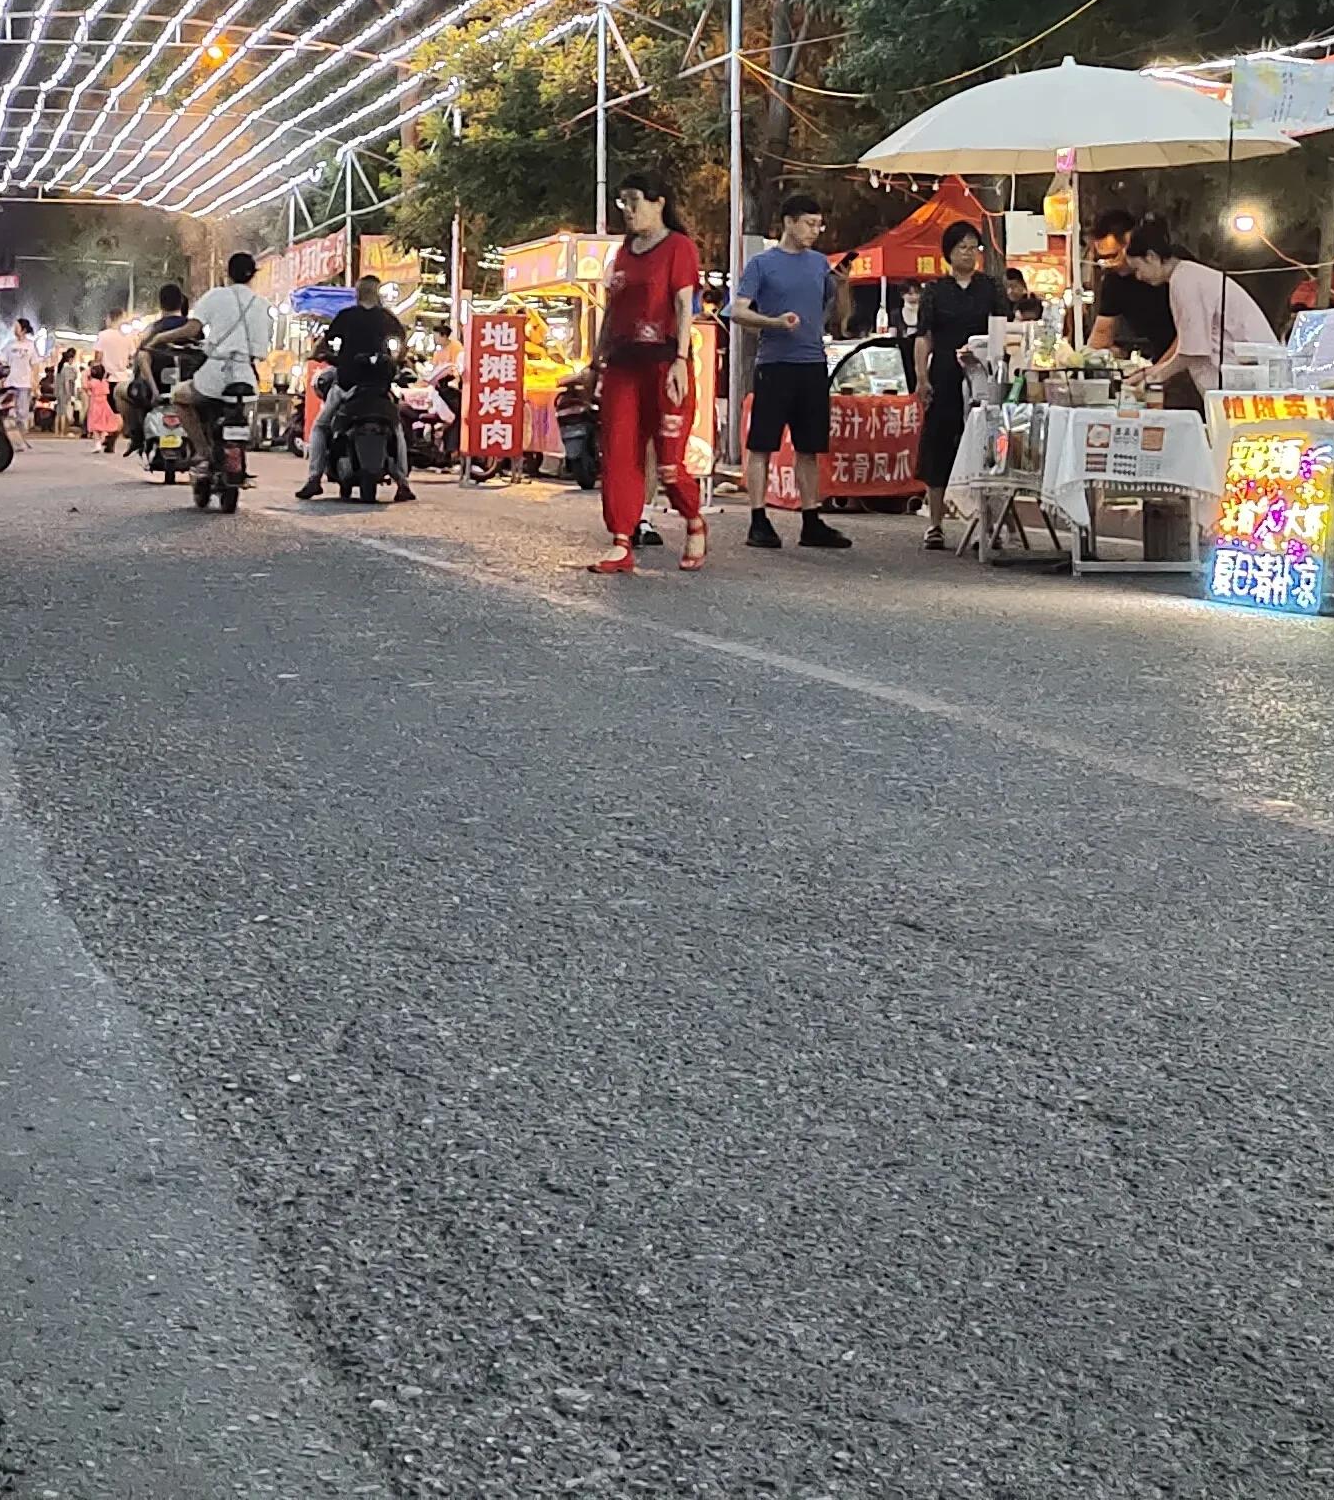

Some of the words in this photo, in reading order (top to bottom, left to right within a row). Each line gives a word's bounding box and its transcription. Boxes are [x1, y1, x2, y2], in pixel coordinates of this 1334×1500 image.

[478, 321, 519, 451] 地摊烤肉
[831, 449, 912, 484] 无骨凤爪
